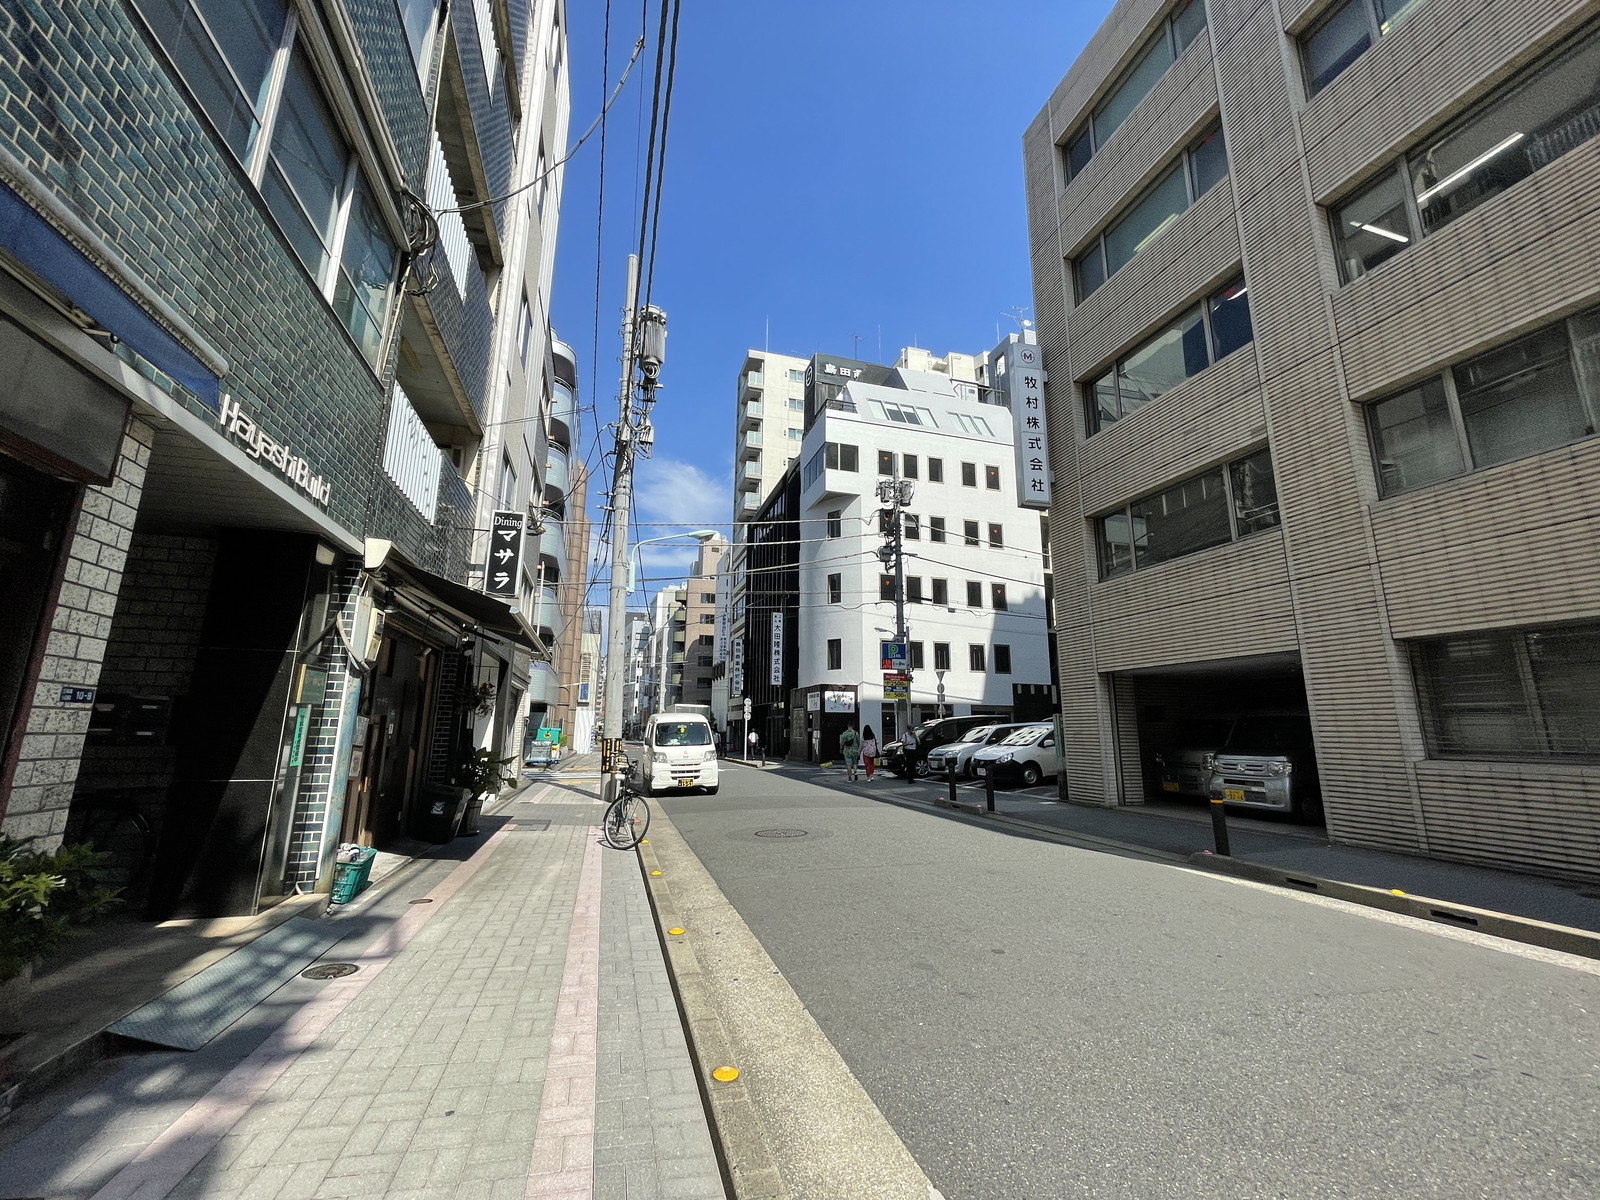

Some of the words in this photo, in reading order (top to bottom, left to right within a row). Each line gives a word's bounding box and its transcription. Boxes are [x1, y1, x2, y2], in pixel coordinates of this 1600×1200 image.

[1024, 376, 1045, 492] 牧村株式会社
[494, 516, 523, 529] Dining
[493, 530, 518, 589] マサラ
[888, 644, 898, 658] P
[76, 691, 93, 701] 10-8
